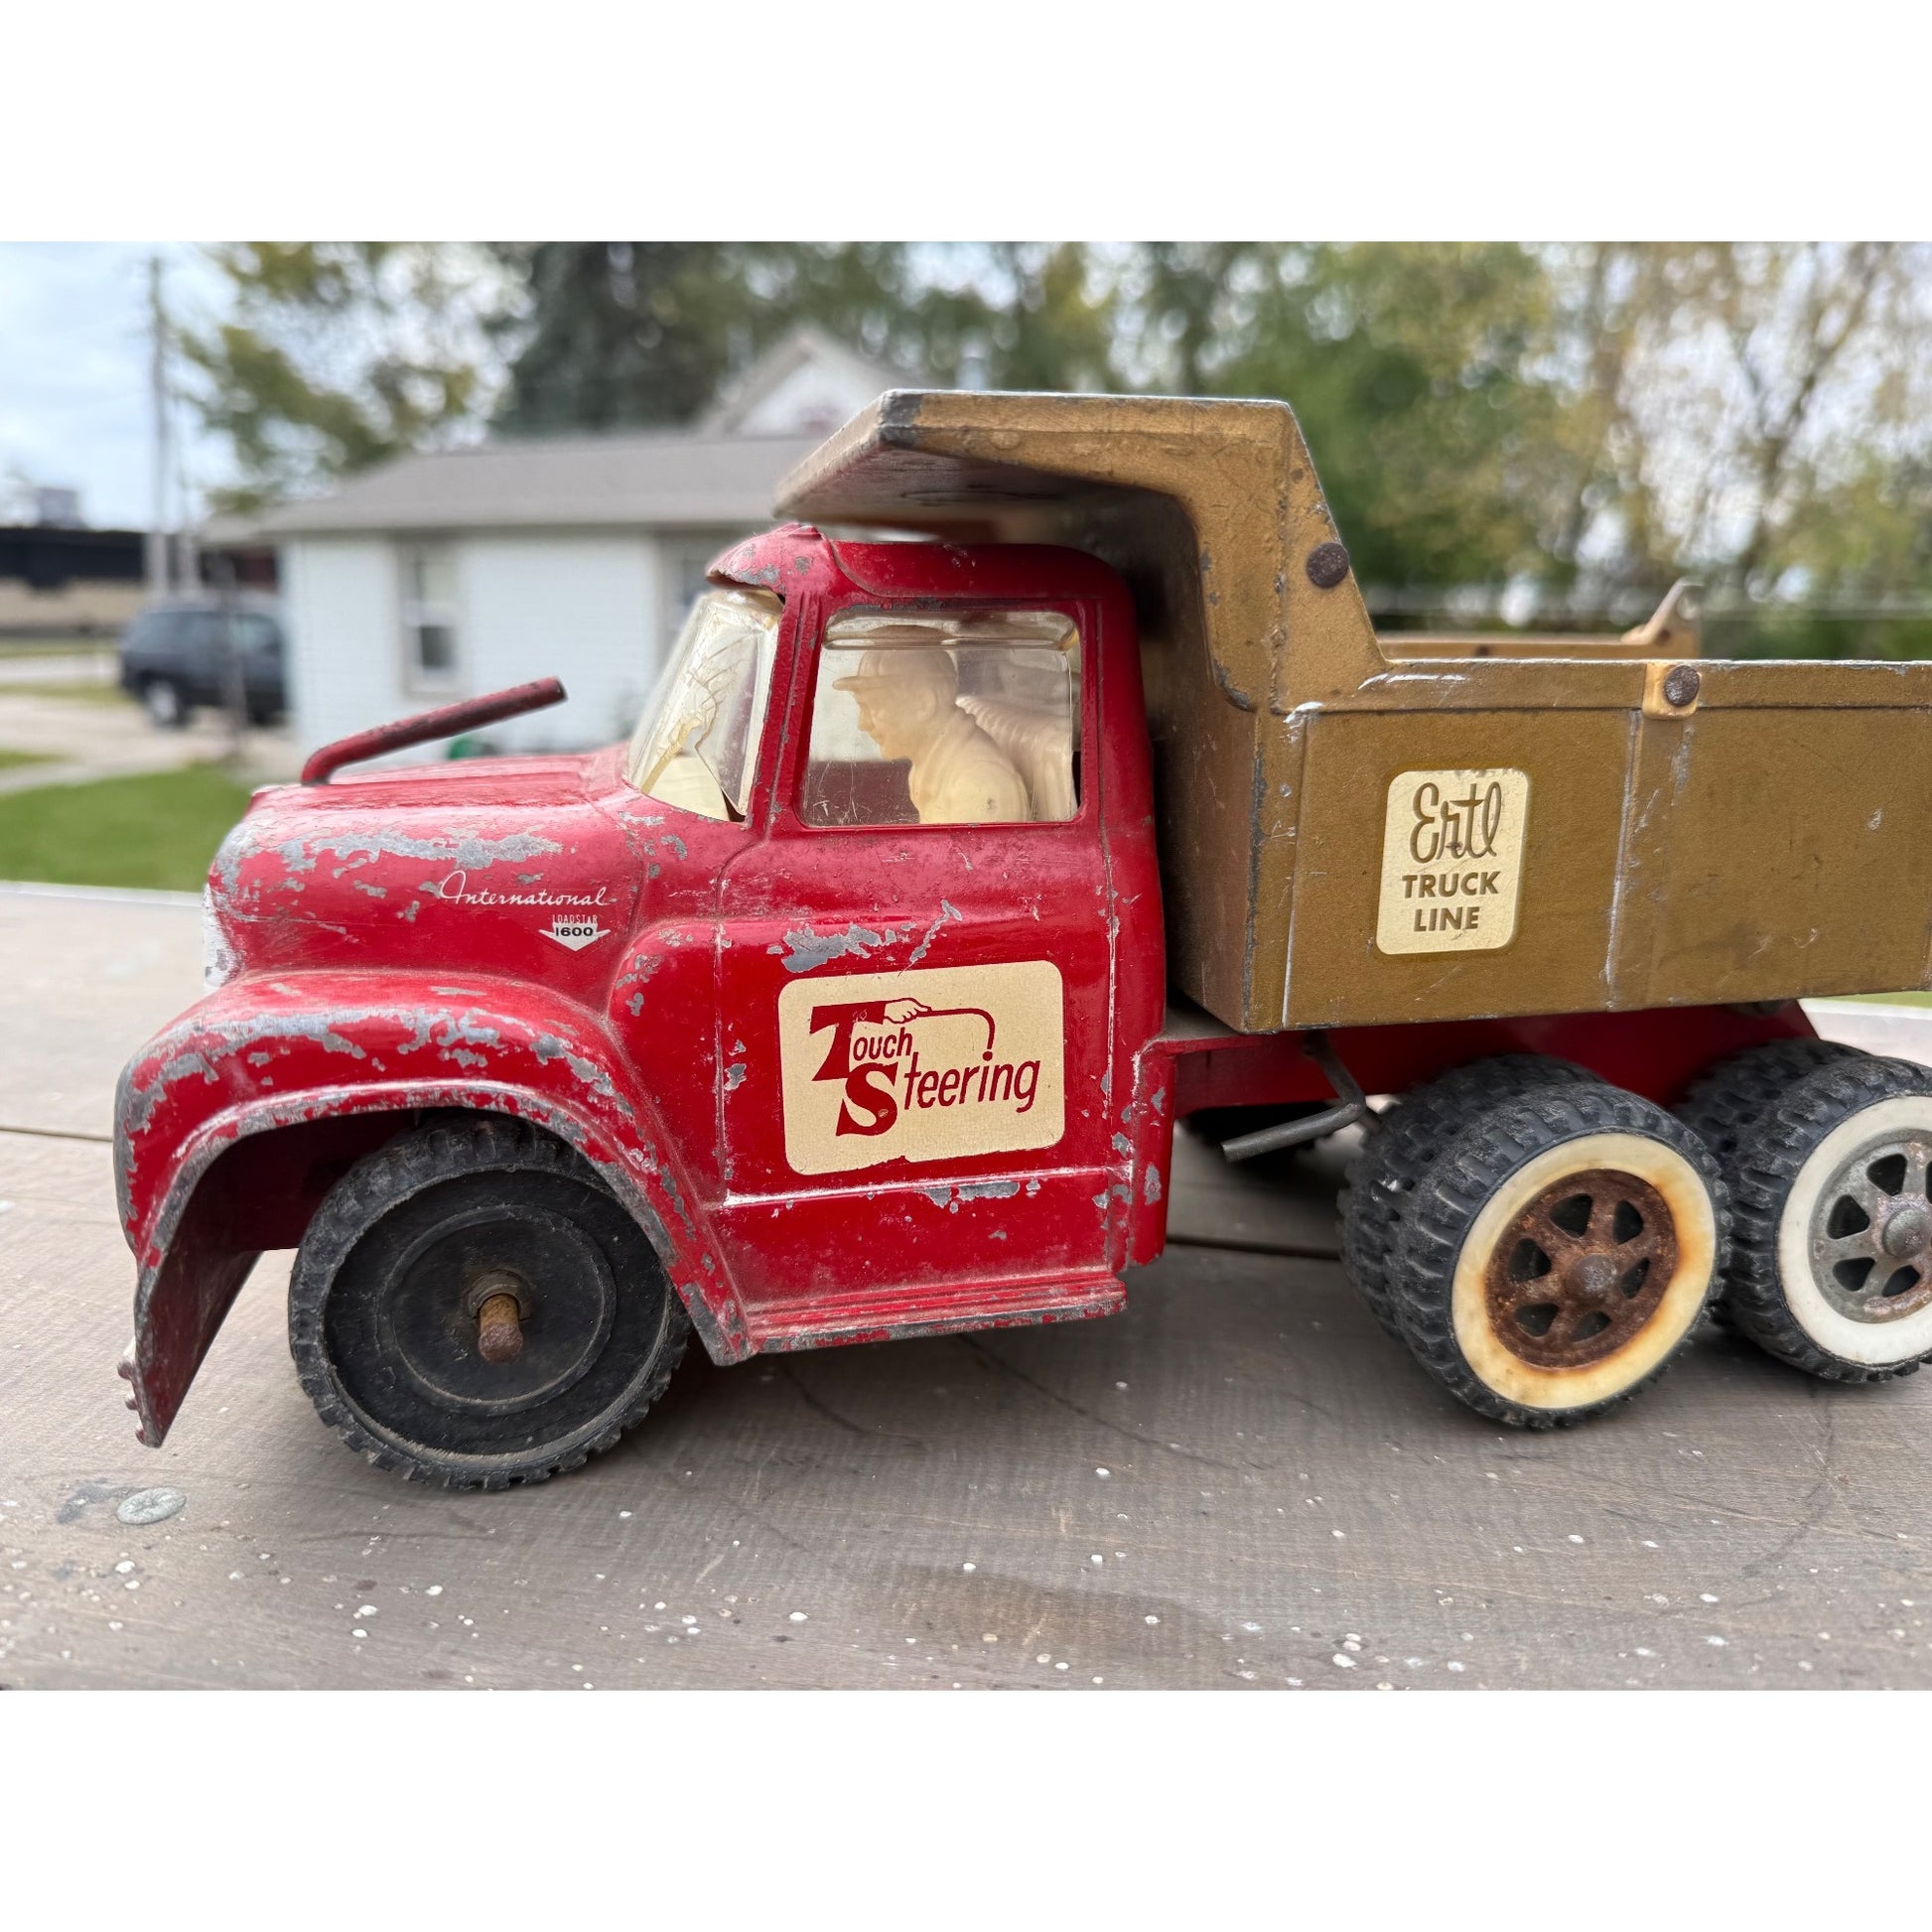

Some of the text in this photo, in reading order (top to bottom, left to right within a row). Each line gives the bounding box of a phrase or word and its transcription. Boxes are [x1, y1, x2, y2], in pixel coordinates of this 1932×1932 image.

[1409, 780, 1502, 864] Ertl
[440, 870, 612, 906] International
[1401, 871, 1502, 899] TRUCK
[552, 913, 598, 924] LOADSTAR
[555, 926, 594, 937] 1600
[1413, 905, 1480, 932] LINE
[809, 1000, 913, 1082] Touch
[835, 1050, 1041, 1138] Steering
